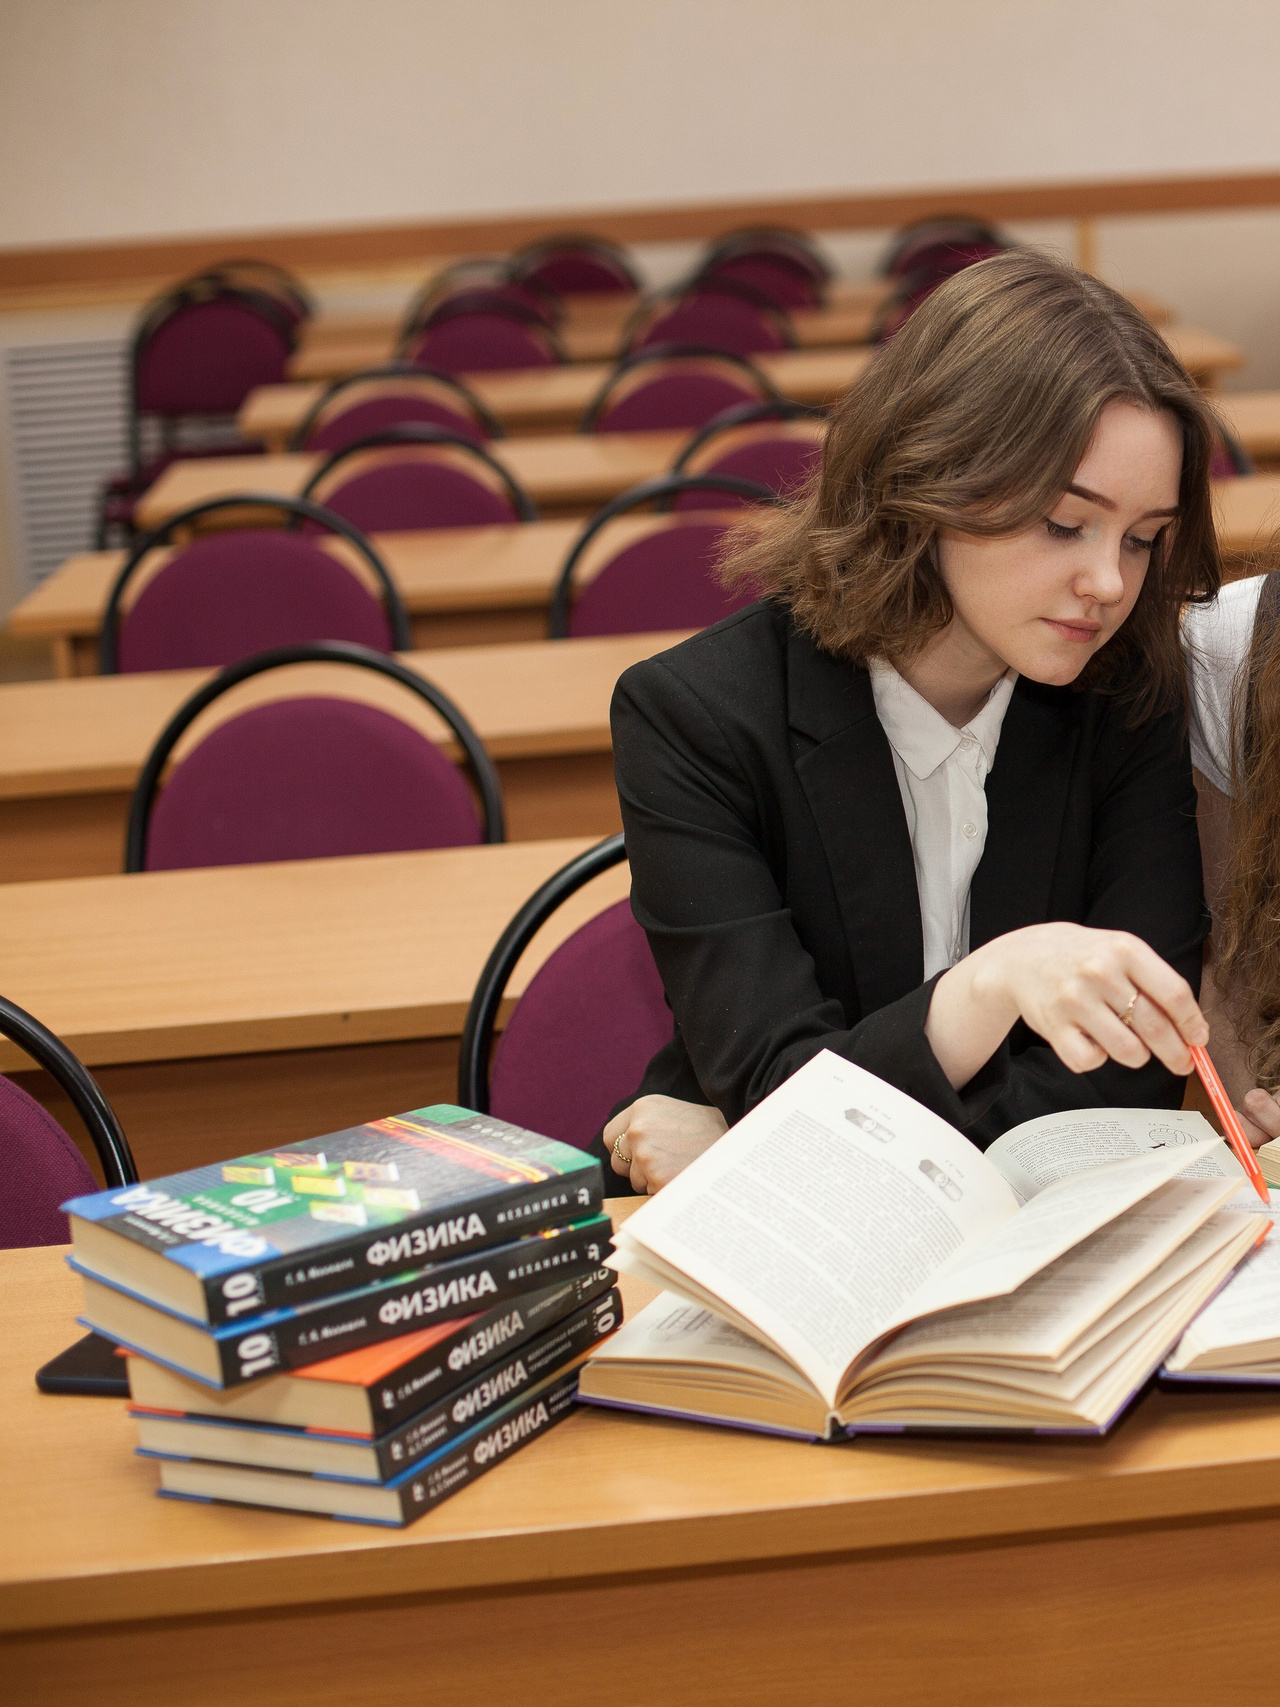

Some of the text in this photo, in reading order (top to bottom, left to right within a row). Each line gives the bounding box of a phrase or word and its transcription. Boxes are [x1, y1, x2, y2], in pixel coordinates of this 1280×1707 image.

[110, 1185, 268, 1258] ФИЗИКА
[230, 1188, 293, 1215] 10
[497, 1194, 568, 1224] МЕХАНИКА
[366, 1213, 487, 1266] ФИЗИКА
[508, 1250, 578, 1280] МЕХАНИКА
[222, 1272, 262, 1317] 10
[378, 1269, 498, 1325] ФИЗИКА
[595, 1294, 616, 1334] 10
[238, 1333, 277, 1378] 10
[447, 1310, 525, 1371] ФИЗИКА
[452, 1359, 529, 1423] ФИЗИКА
[473, 1401, 549, 1465] ФИЗИКА
